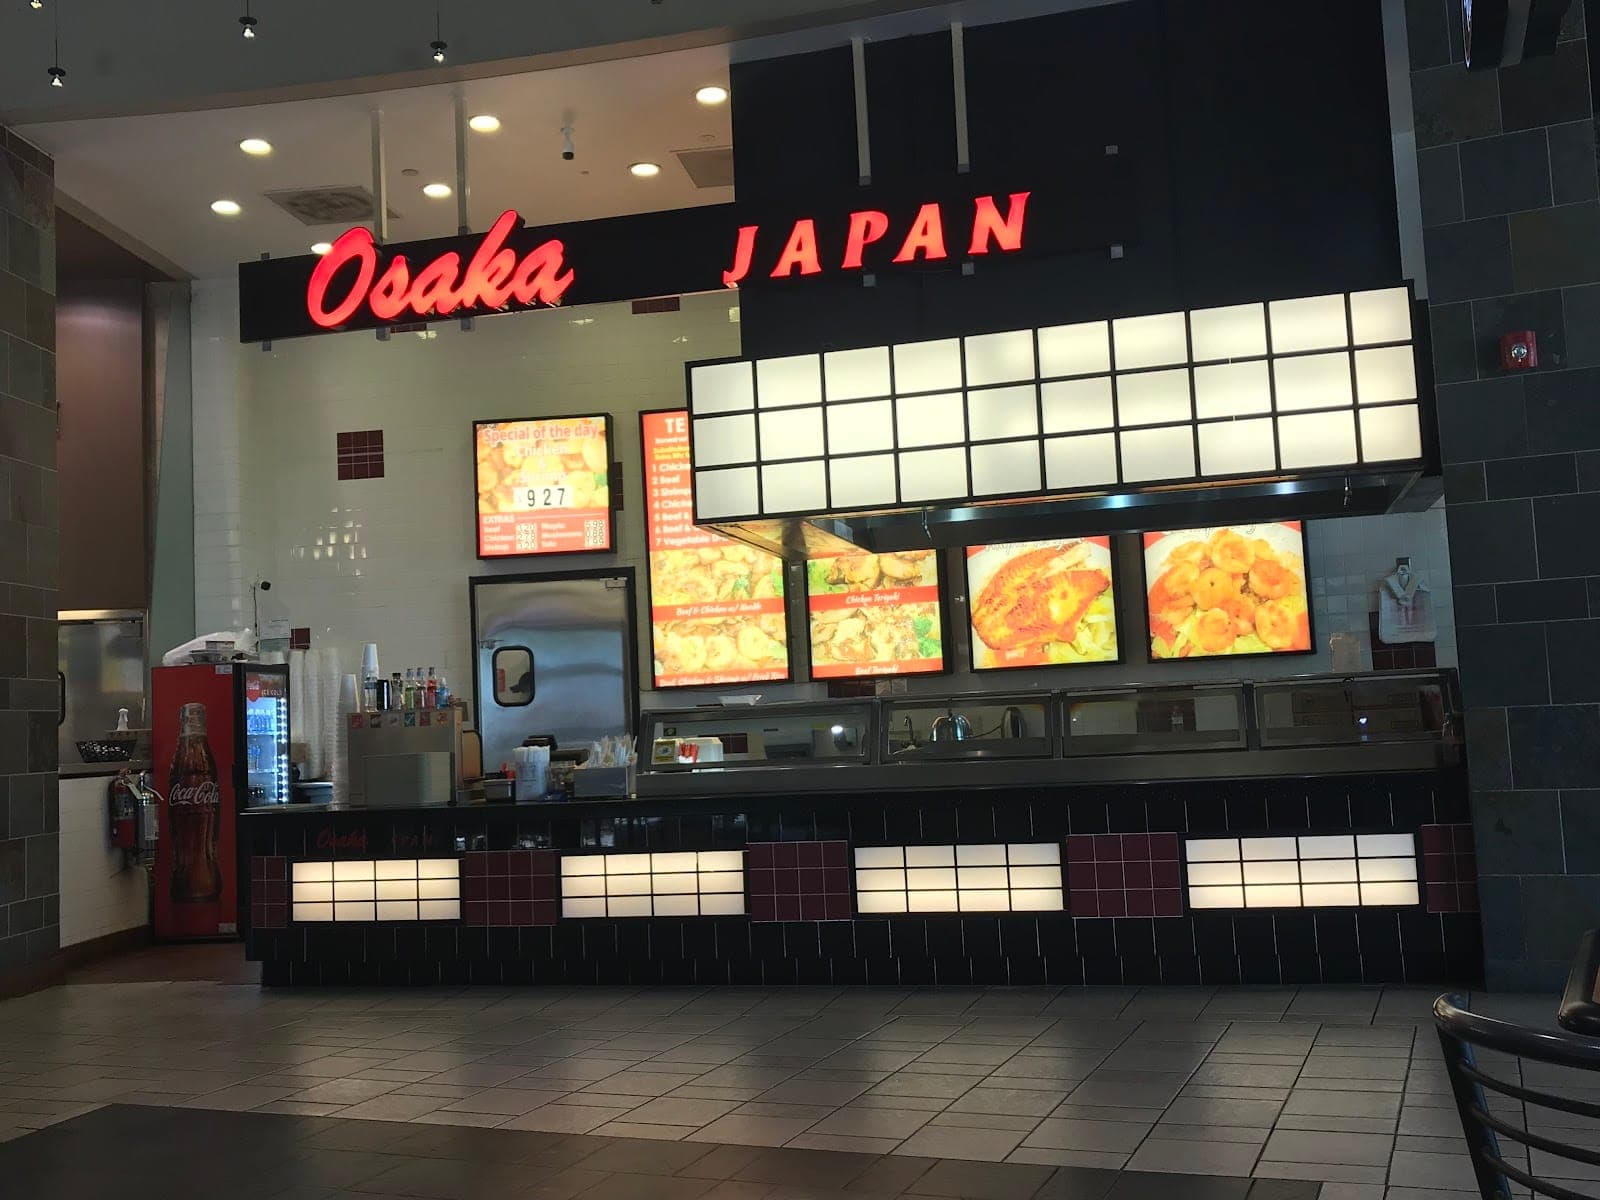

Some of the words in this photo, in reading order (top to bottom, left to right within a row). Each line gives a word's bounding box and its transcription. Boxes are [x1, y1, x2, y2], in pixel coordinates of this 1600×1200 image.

[308, 210, 574, 327] Osaka
[723, 191, 1031, 286] JAPAN
[484, 425, 530, 441] Special
[533, 425, 546, 438] of
[550, 424, 571, 437] the
[575, 423, 598, 438] day
